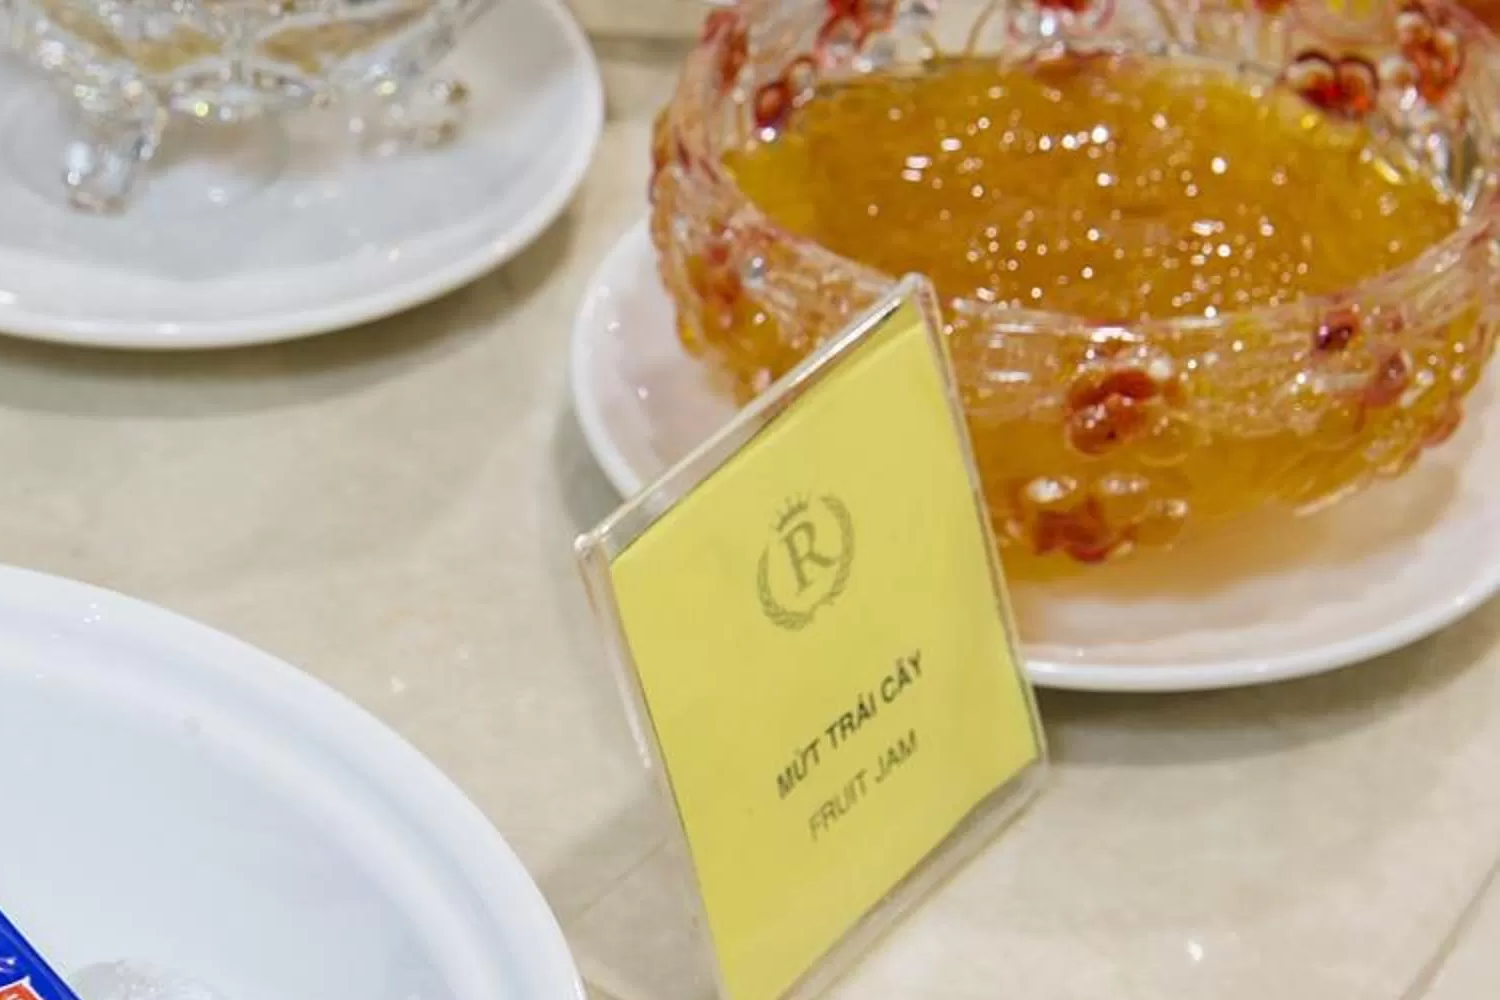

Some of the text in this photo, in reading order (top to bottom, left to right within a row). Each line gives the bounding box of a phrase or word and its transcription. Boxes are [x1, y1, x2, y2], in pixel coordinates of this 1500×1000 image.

[779, 520, 838, 596] R
[808, 727, 918, 842] FRUIT JAM
